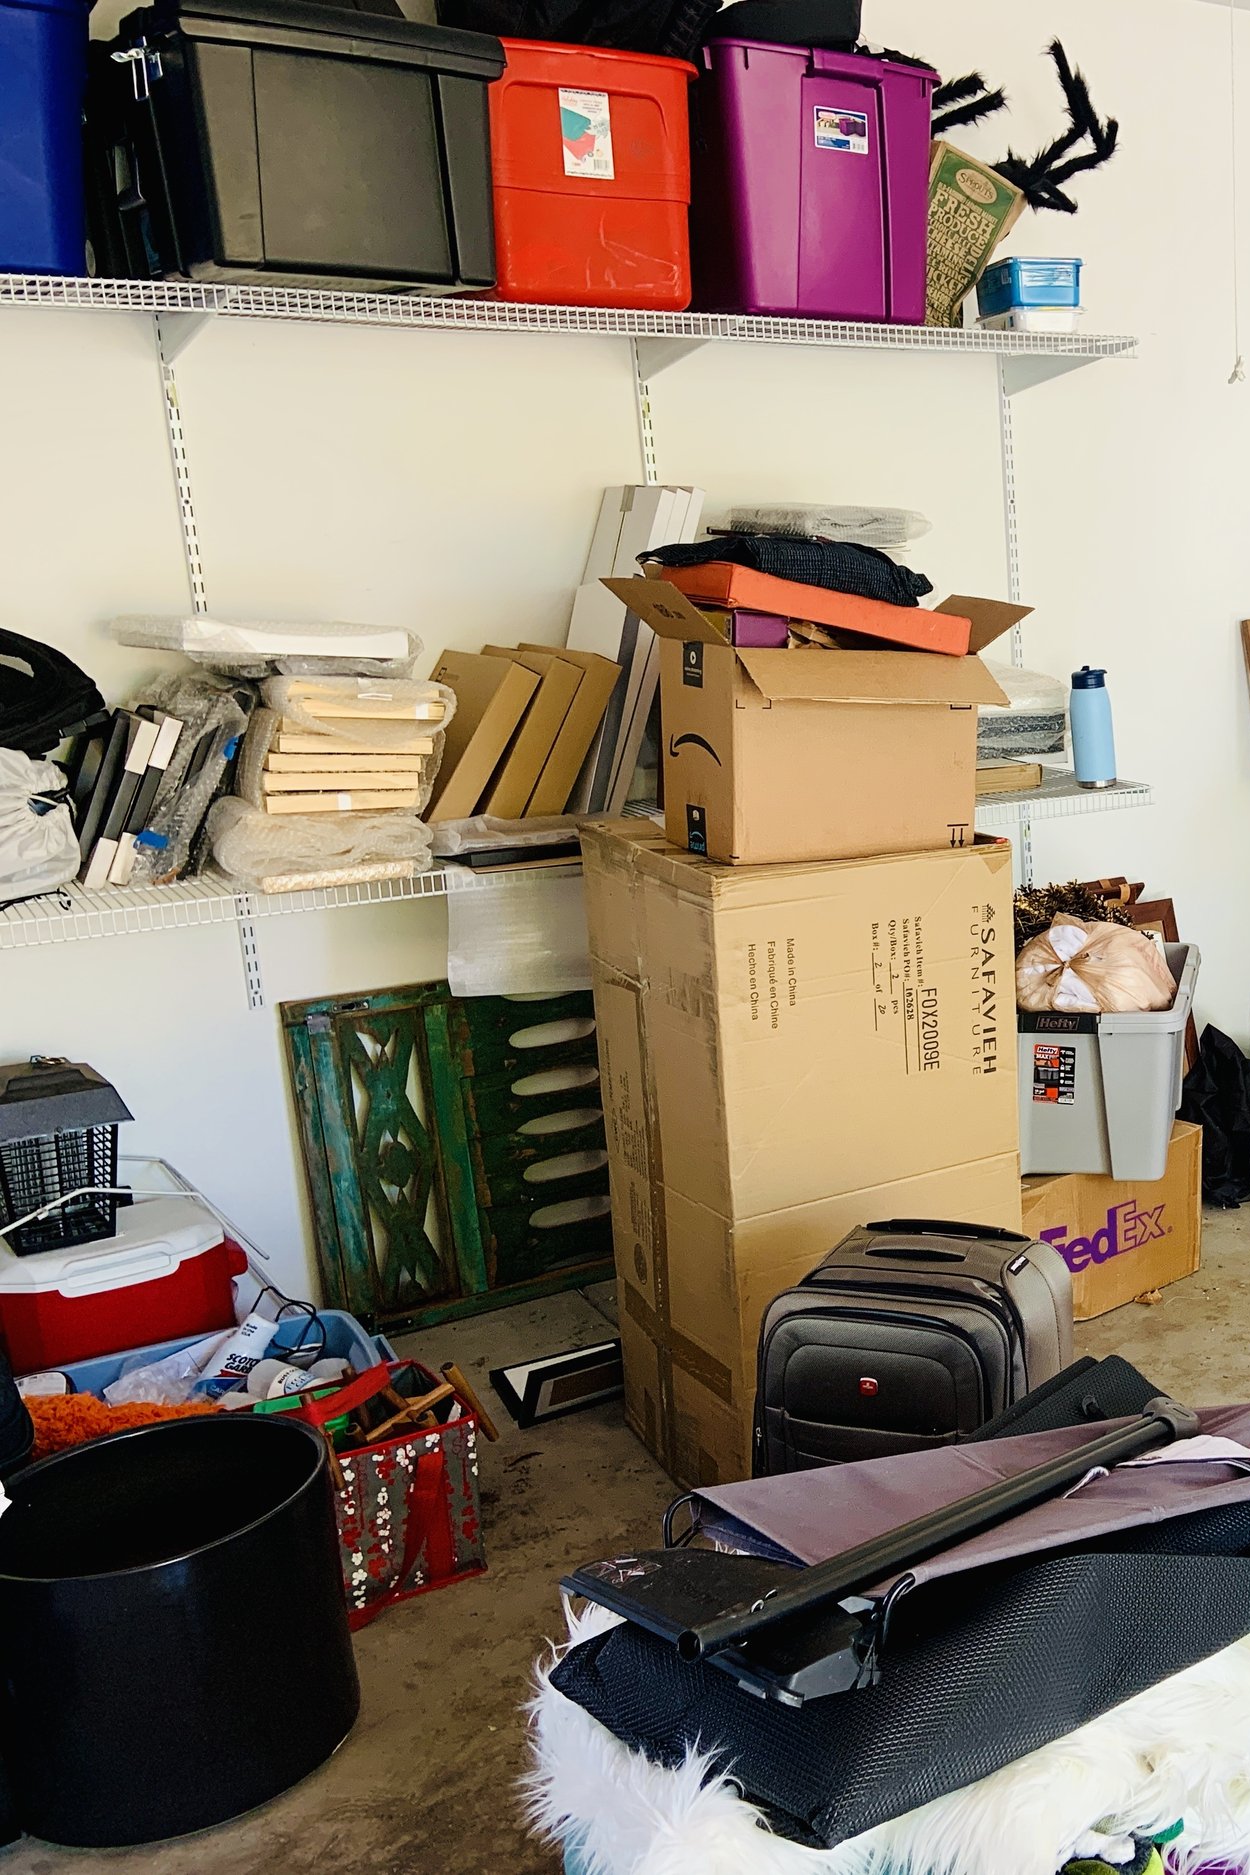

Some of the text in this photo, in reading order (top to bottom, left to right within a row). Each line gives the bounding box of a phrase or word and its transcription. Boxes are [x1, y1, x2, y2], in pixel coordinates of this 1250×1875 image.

[927, 204, 989, 249] PRODUCE
[932, 189, 996, 239] FRESH
[748, 943, 759, 1020] Hecho en China
[767, 941, 778, 984] Fabriqué
[787, 938, 797, 1006] Made in China
[769, 986, 777, 999] en
[875, 984, 882, 993] of
[970, 905, 981, 1075] FURNITURE
[981, 927, 997, 1074] SAFAVIEH
[1039, 1018, 1076, 1030] Hefty
[1040, 1199, 1166, 1273] FedEx
[227, 1353, 261, 1367] SCOTC
